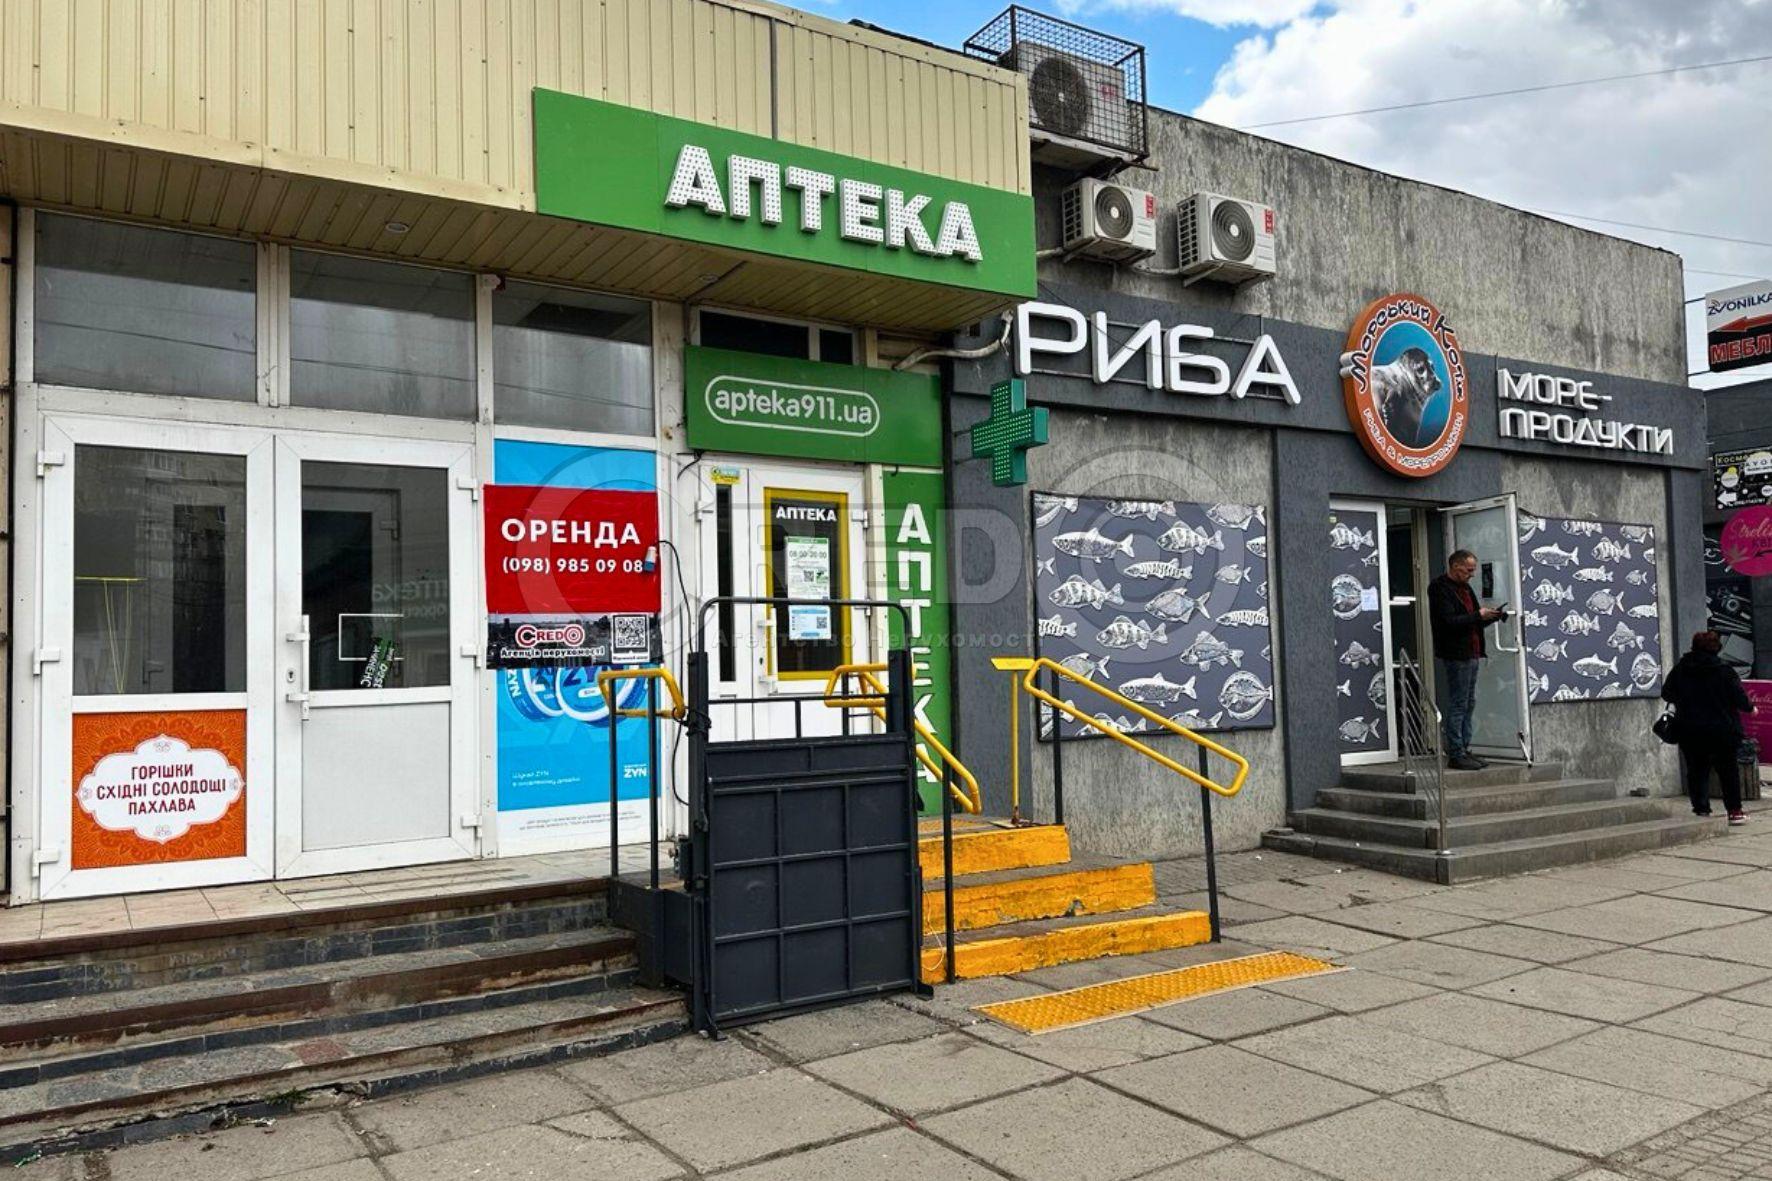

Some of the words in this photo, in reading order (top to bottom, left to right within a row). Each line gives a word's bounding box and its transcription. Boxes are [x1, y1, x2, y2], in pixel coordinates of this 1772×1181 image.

[664, 144, 983, 262] АПТЕКА
[1016, 301, 1300, 404] РИБА
[1711, 334, 1772, 364] МЕБЛ
[1498, 368, 1612, 410] МОРЕ-
[715, 389, 872, 424] apteka911.ua
[1500, 408, 1673, 455] ПРОДУКТИ
[776, 506, 838, 521] АПТЕКА
[501, 518, 641, 549] ОРЕНДА
[503, 556, 550, 574] (098)
[556, 558, 590, 572] 985
[595, 559, 617, 573] 09
[622, 559, 643, 573] 08
[516, 624, 585, 647] CREDO
[131, 764, 194, 780] ГОРІШКИ
[623, 767, 647, 778] ZYN
[96, 784, 147, 800] СХІДНІ
[152, 779, 226, 796] СОЛОДОЩІ
[128, 798, 196, 815] ПАХЛАВА
